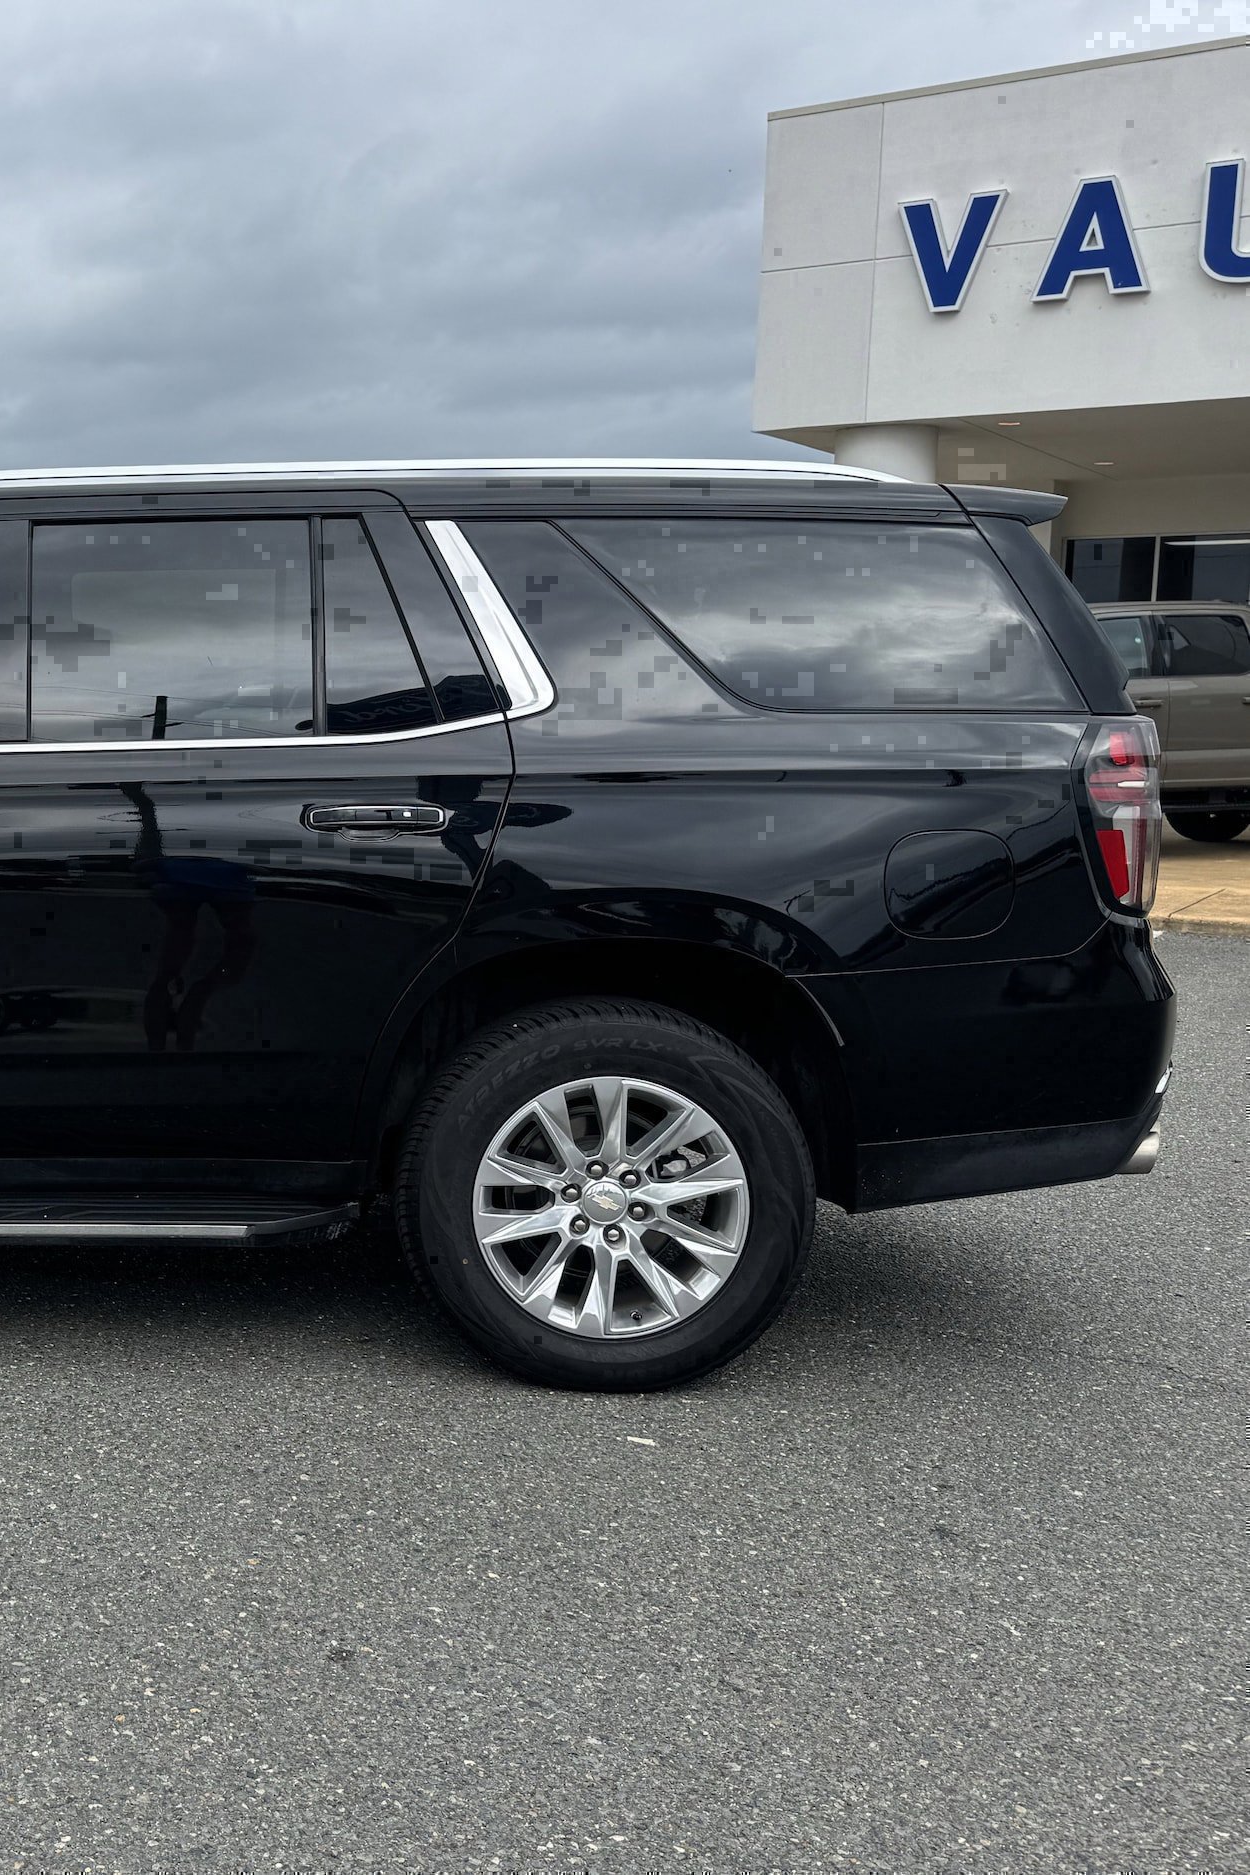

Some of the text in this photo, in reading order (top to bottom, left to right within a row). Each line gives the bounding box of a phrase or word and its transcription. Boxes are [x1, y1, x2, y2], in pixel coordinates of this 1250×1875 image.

[457, 1038, 665, 1130] ATREZZO SVR LX
